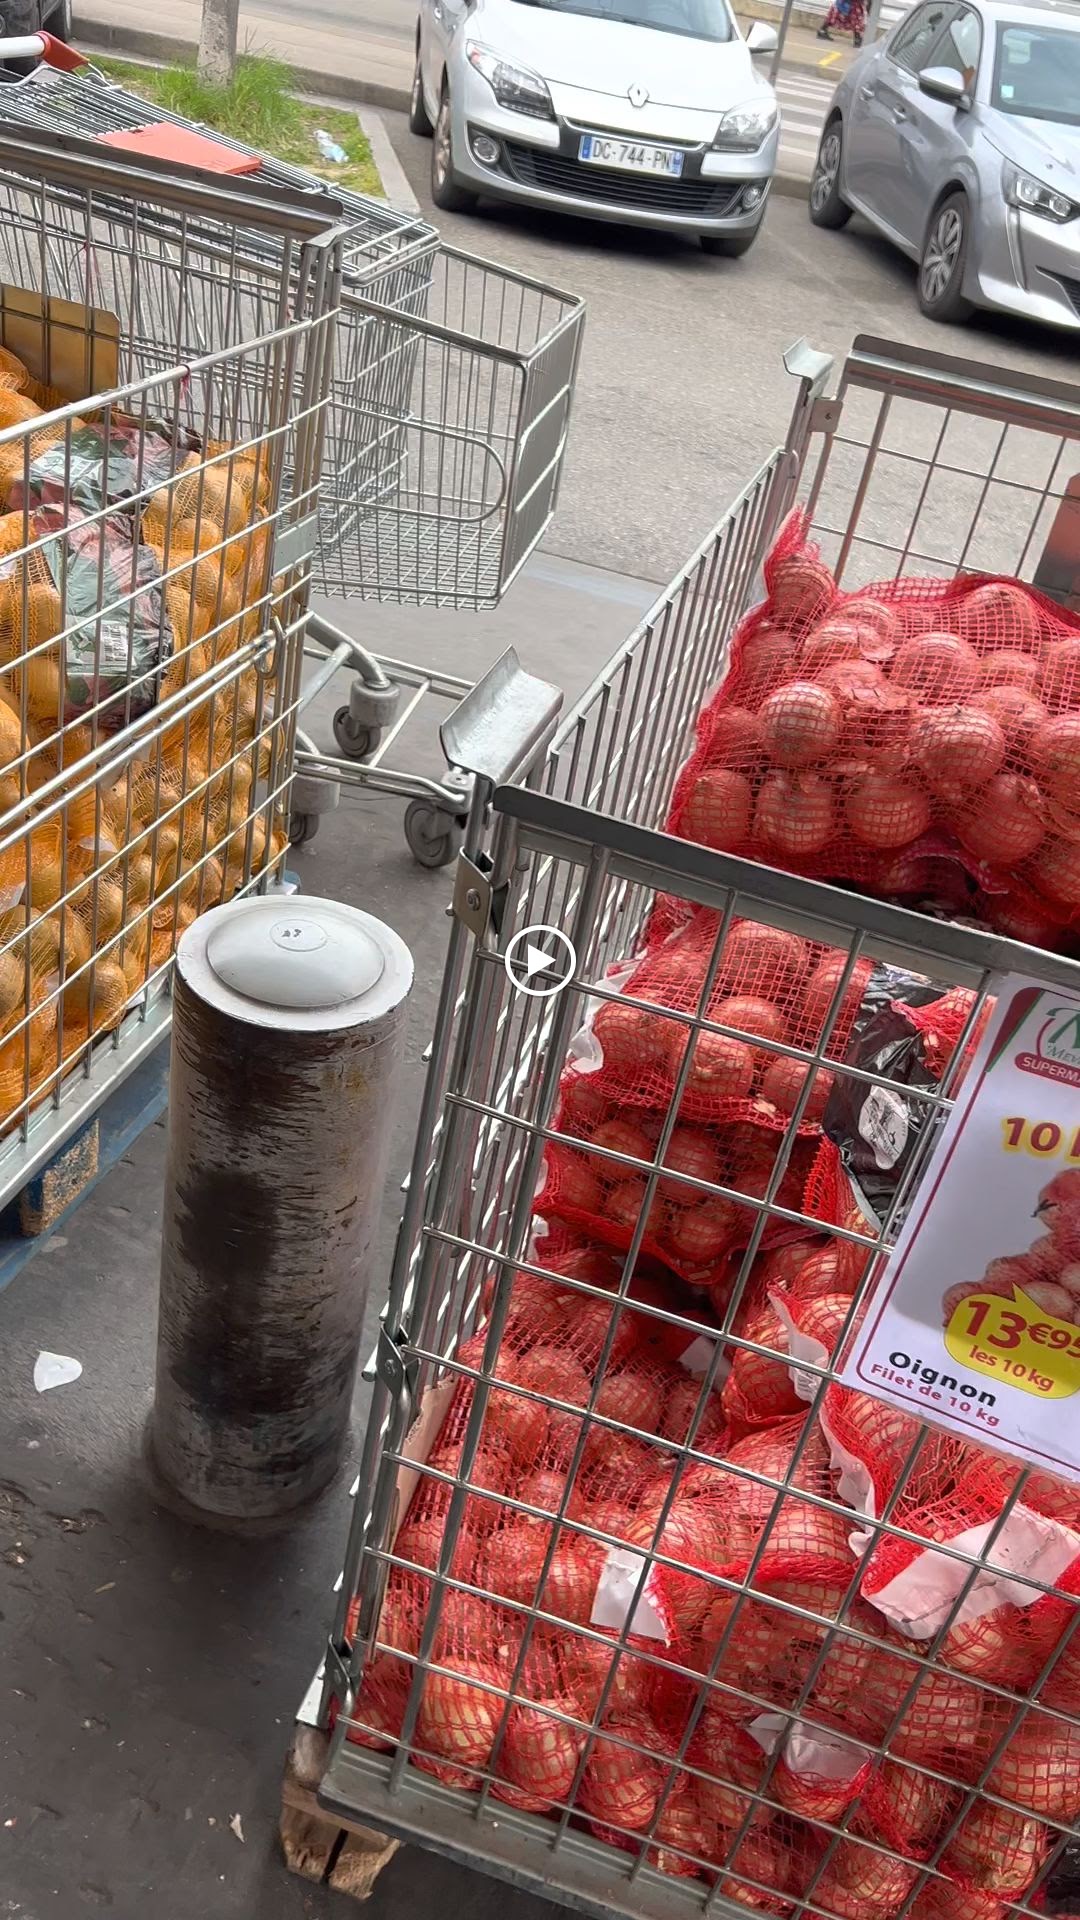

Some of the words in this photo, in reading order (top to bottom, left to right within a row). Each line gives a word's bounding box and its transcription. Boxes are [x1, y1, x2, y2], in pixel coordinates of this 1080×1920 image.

[1021, 1056, 1080, 1083] SUPERM
[1006, 1116, 1062, 1153] 10
[888, 1351, 996, 1407] Oignon
[969, 1345, 998, 1366] les
[1003, 1359, 1027, 1378] 10
[1027, 1368, 1055, 1392] kg
[870, 1363, 915, 1389] Filet
[918, 1385, 942, 1401] de
[949, 1396, 972, 1412] 10
[975, 1408, 1000, 1426] kg
